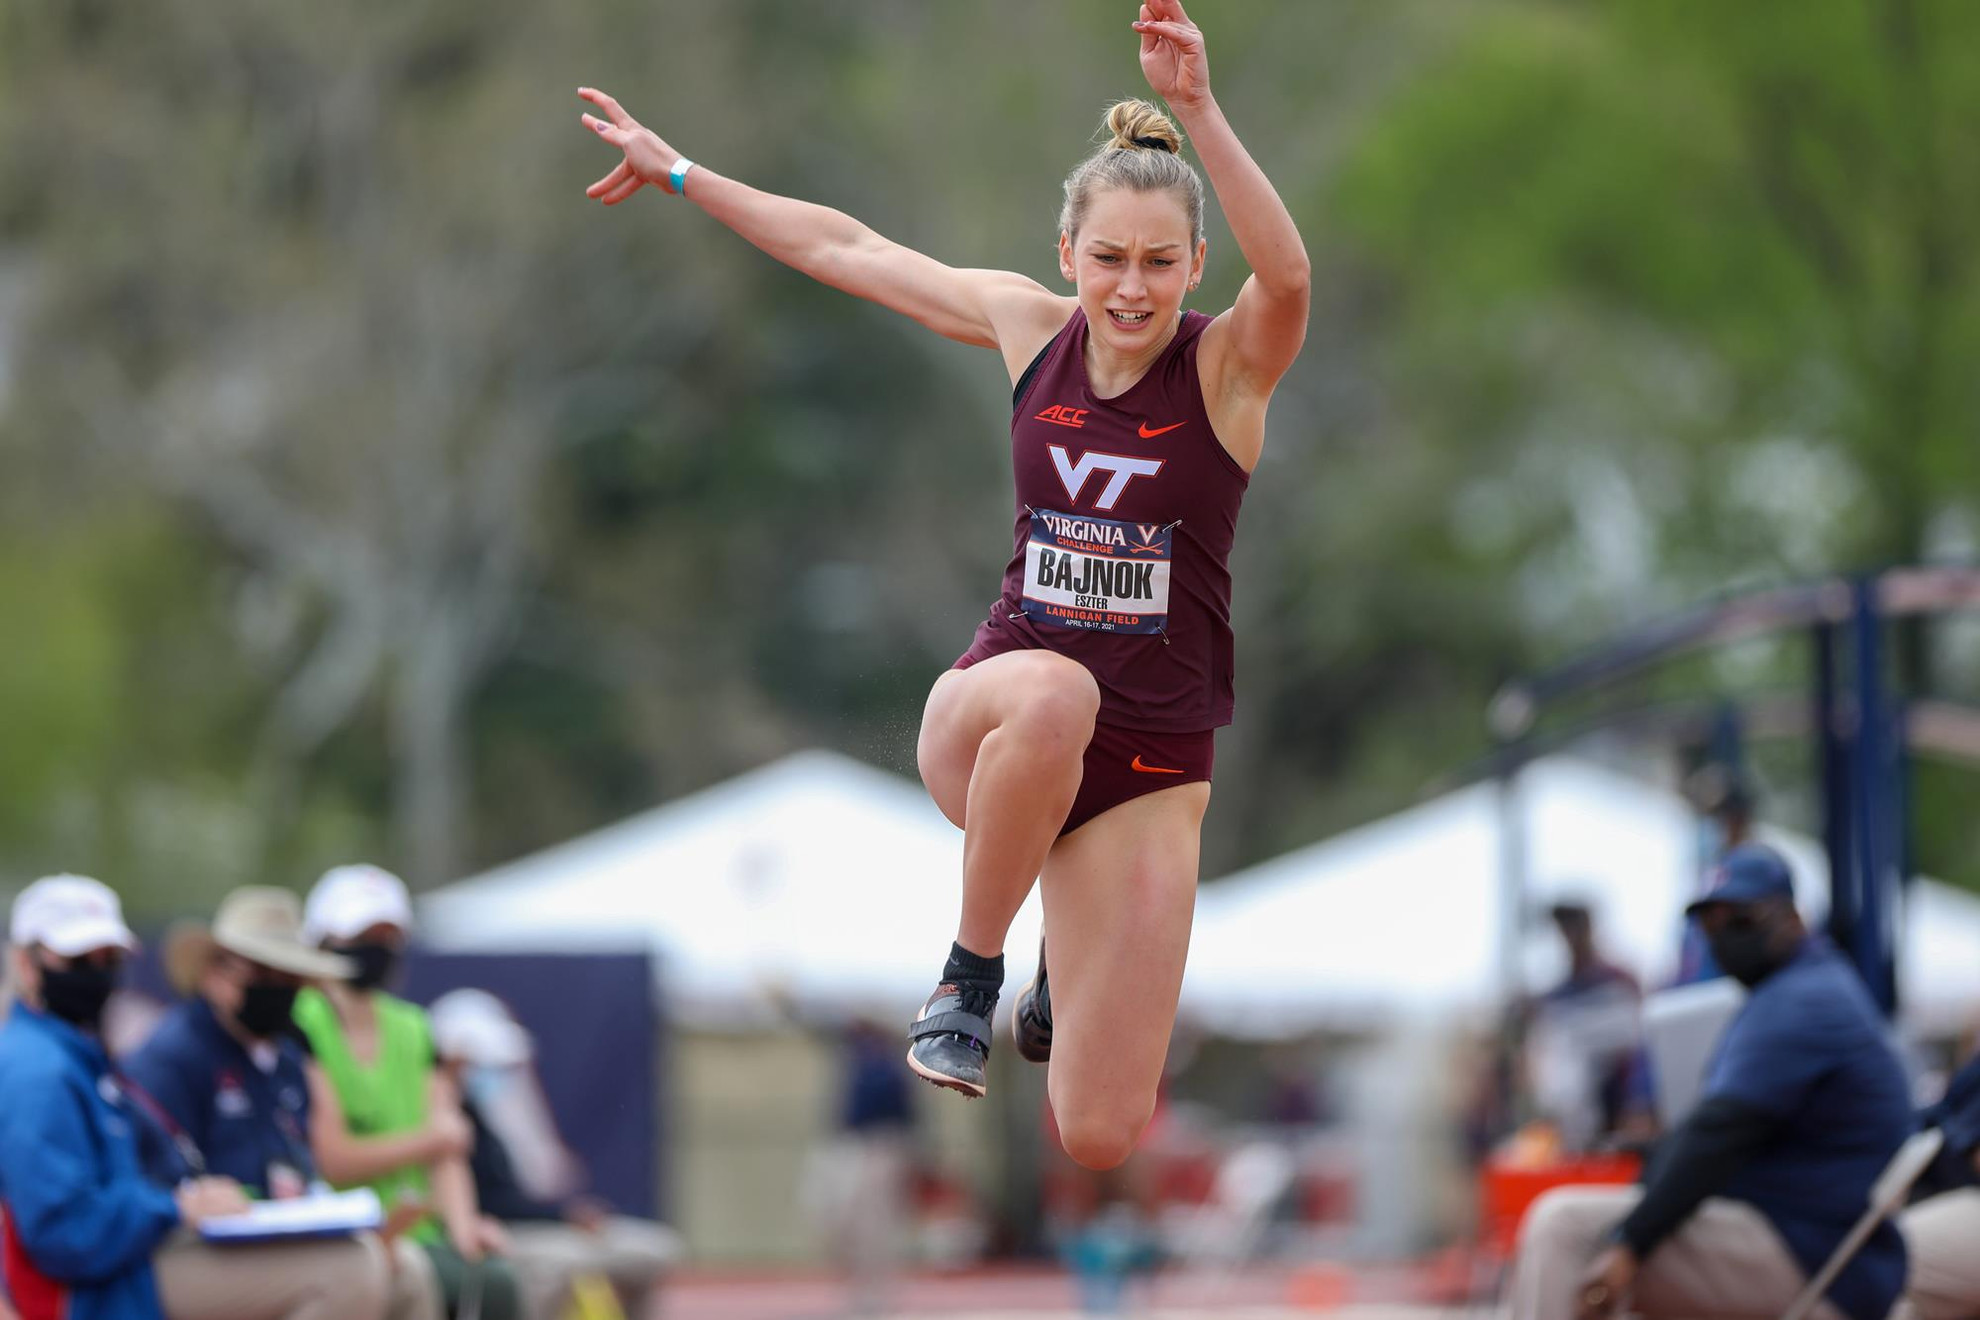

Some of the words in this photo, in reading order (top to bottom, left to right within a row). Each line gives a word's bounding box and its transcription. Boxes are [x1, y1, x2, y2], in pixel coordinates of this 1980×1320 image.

[1036, 404, 1089, 427] ACC
[1046, 443, 1166, 511] VT
[1042, 515, 1127, 546] VIRGINIA
[1057, 537, 1114, 554] CHALLENGE
[1037, 547, 1155, 600] BAJNOK
[1075, 595, 1108, 610] ESZTER
[1046, 606, 1102, 622] LANNIGAN
[1107, 614, 1139, 625] FIELD
[1065, 619, 1083, 627] APRIL
